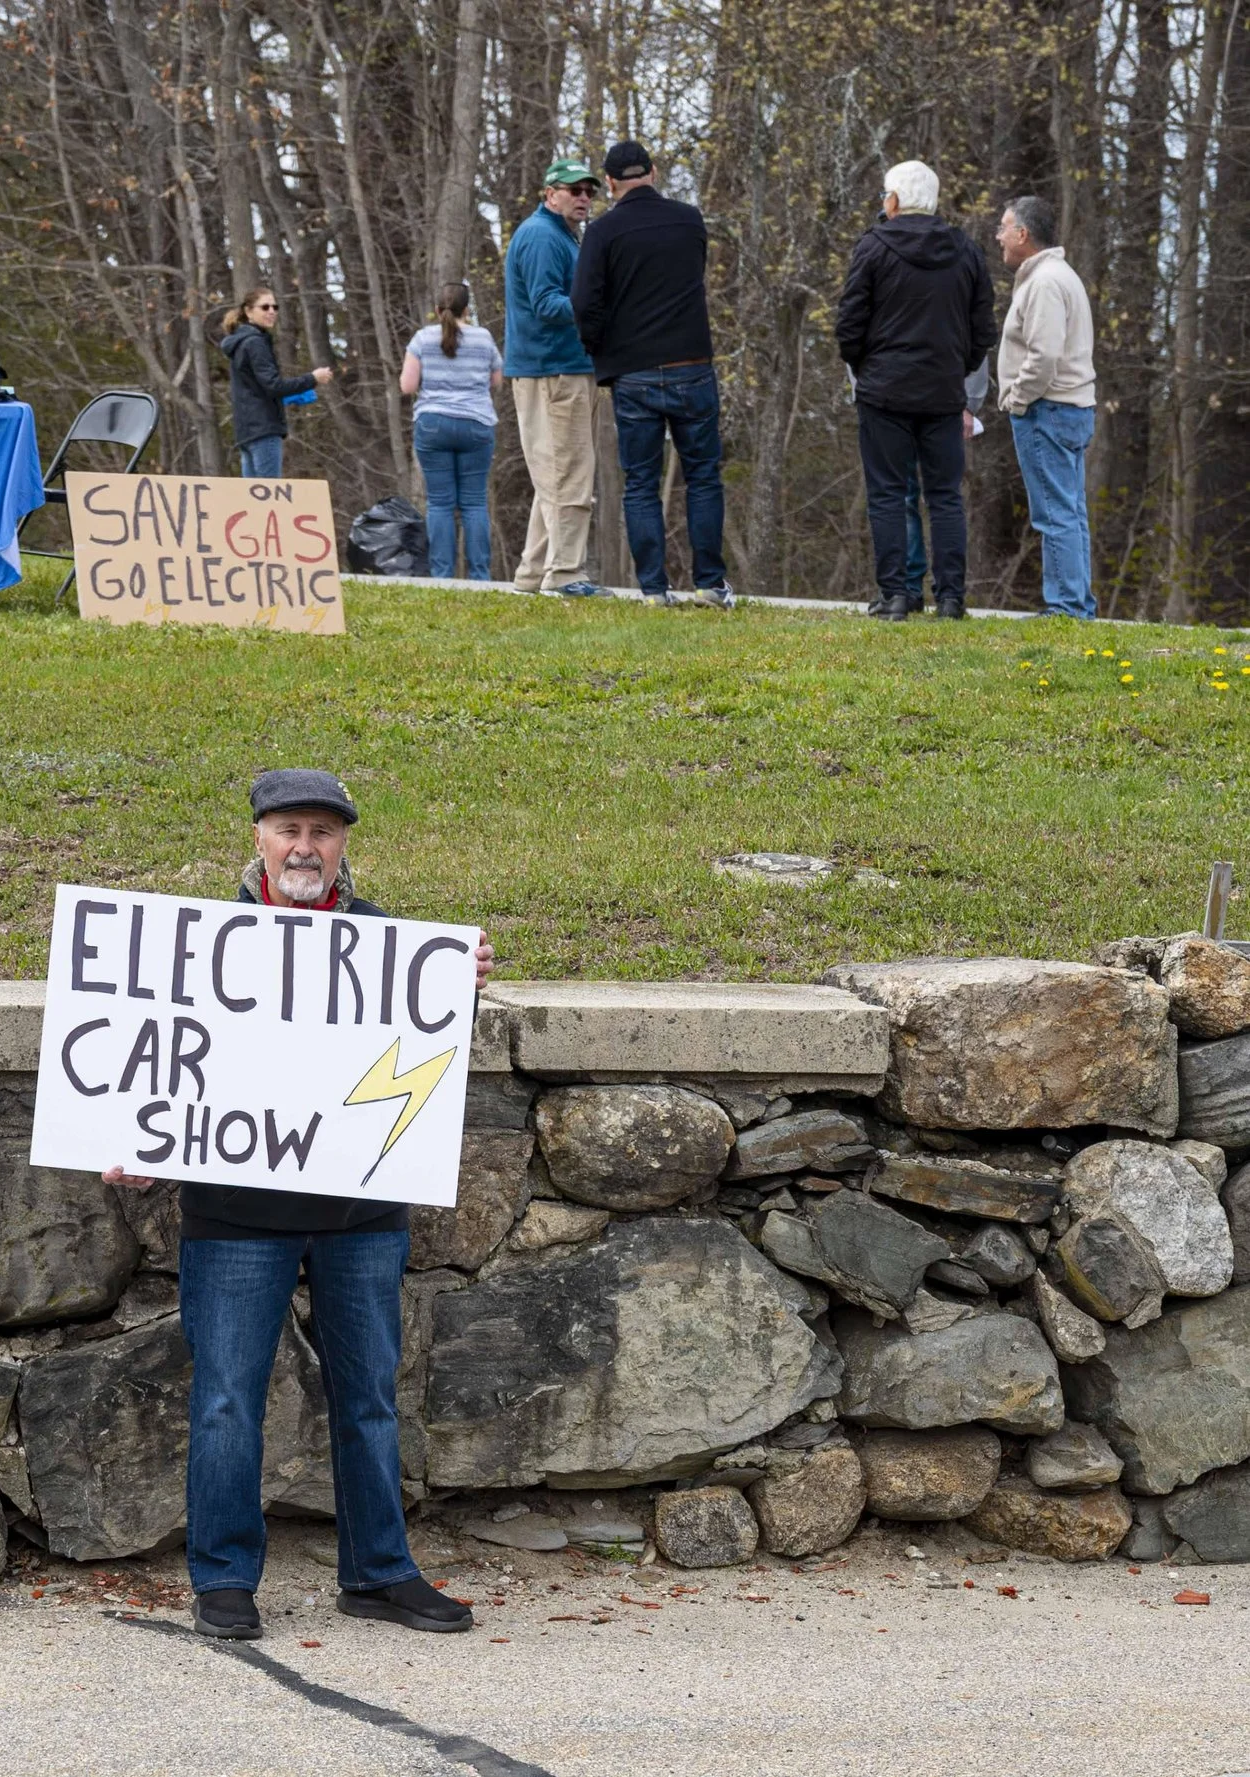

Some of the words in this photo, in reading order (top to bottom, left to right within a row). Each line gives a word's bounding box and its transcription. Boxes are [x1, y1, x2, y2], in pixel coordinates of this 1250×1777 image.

[83, 476, 212, 554] SAVE
[250, 482, 293, 503] ON
[224, 509, 332, 564] GAS
[90, 558, 146, 601] GO
[158, 556, 337, 608] ELECTRIC
[71, 899, 469, 1034] ELECTRIC
[61, 1016, 211, 1101] CAR
[136, 1100, 323, 1172] SHOW
